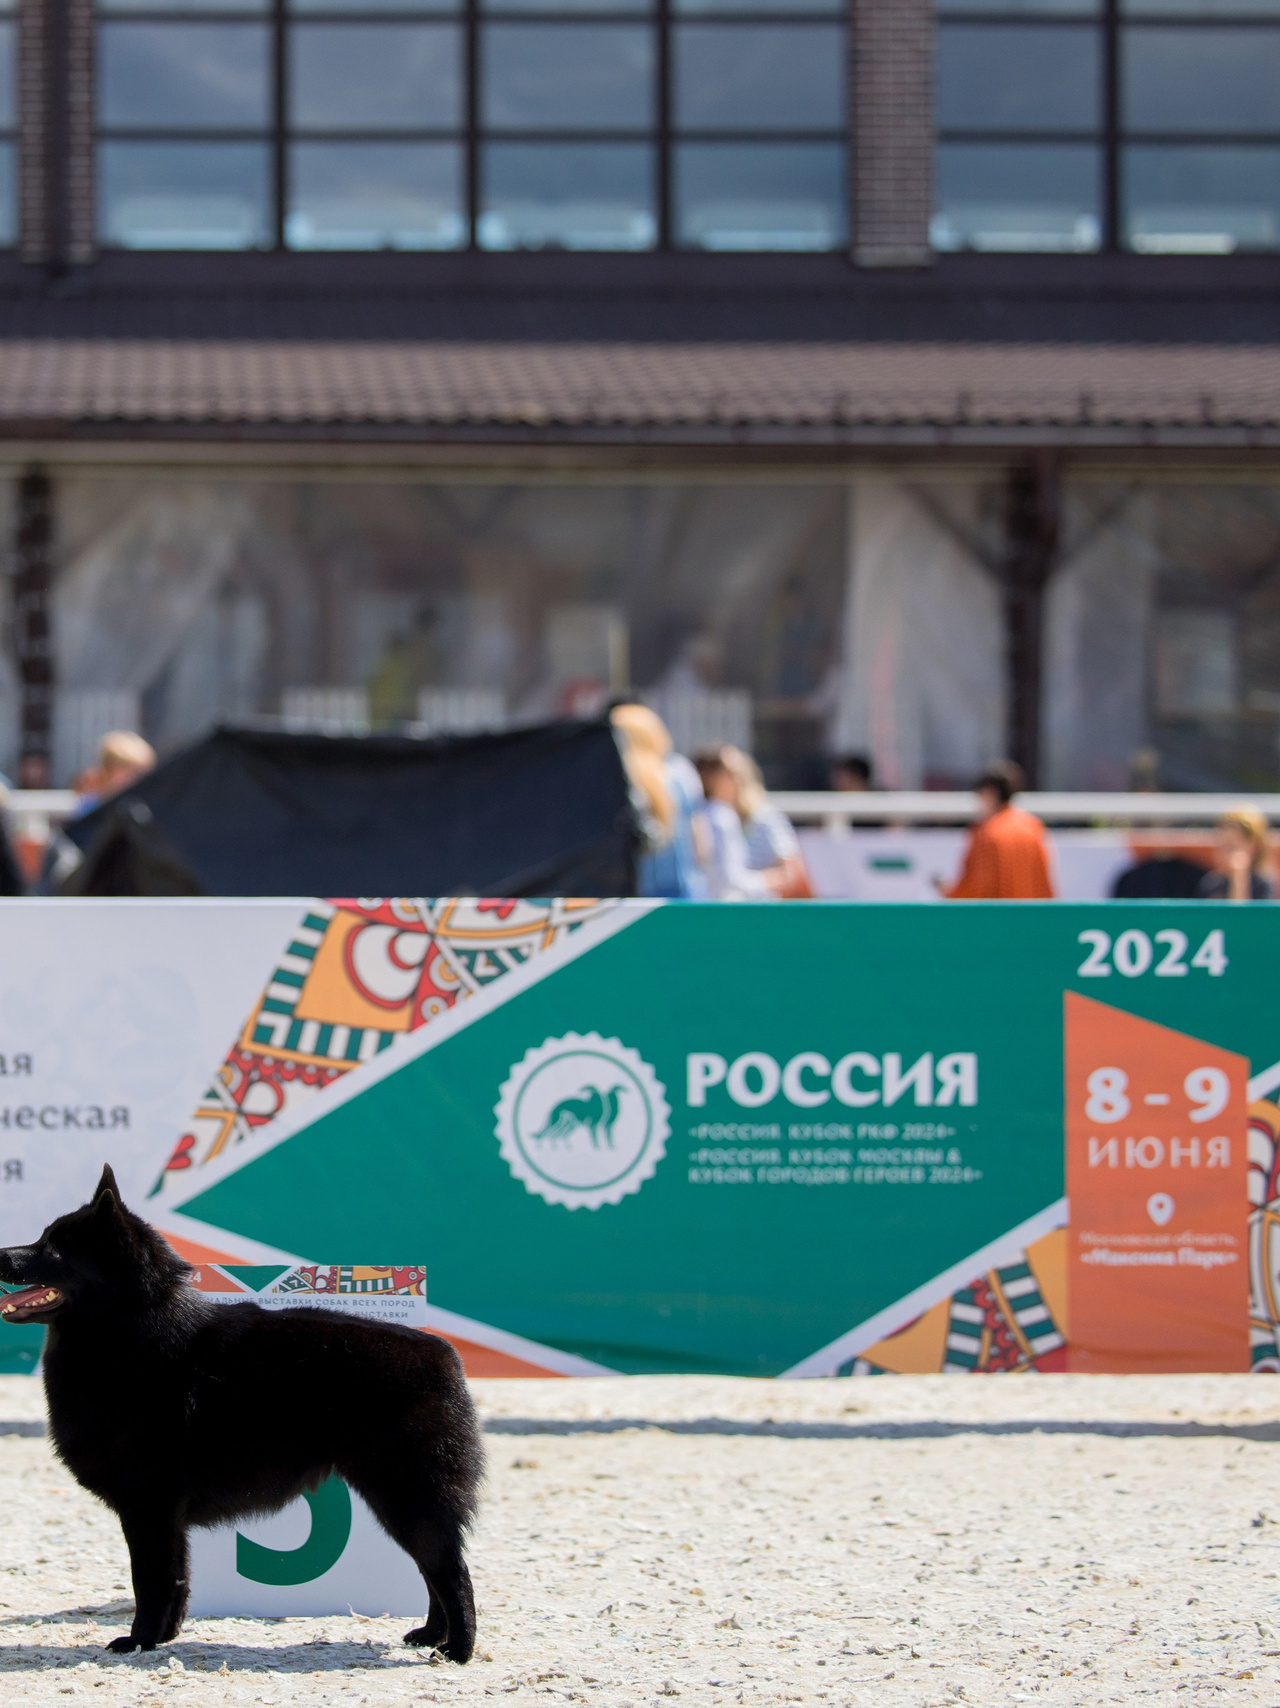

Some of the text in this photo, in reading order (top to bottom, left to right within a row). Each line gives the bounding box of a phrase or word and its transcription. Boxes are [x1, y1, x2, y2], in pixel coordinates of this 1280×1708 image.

[1077, 928, 1229, 978] 2024
[687, 1051, 978, 1108] РОССИЯ
[1088, 1136, 1230, 1169] ИЮНЯ
[258, 1297, 312, 1305] ВЫСТАВКИ
[381, 1300, 415, 1308] ПОРОД
